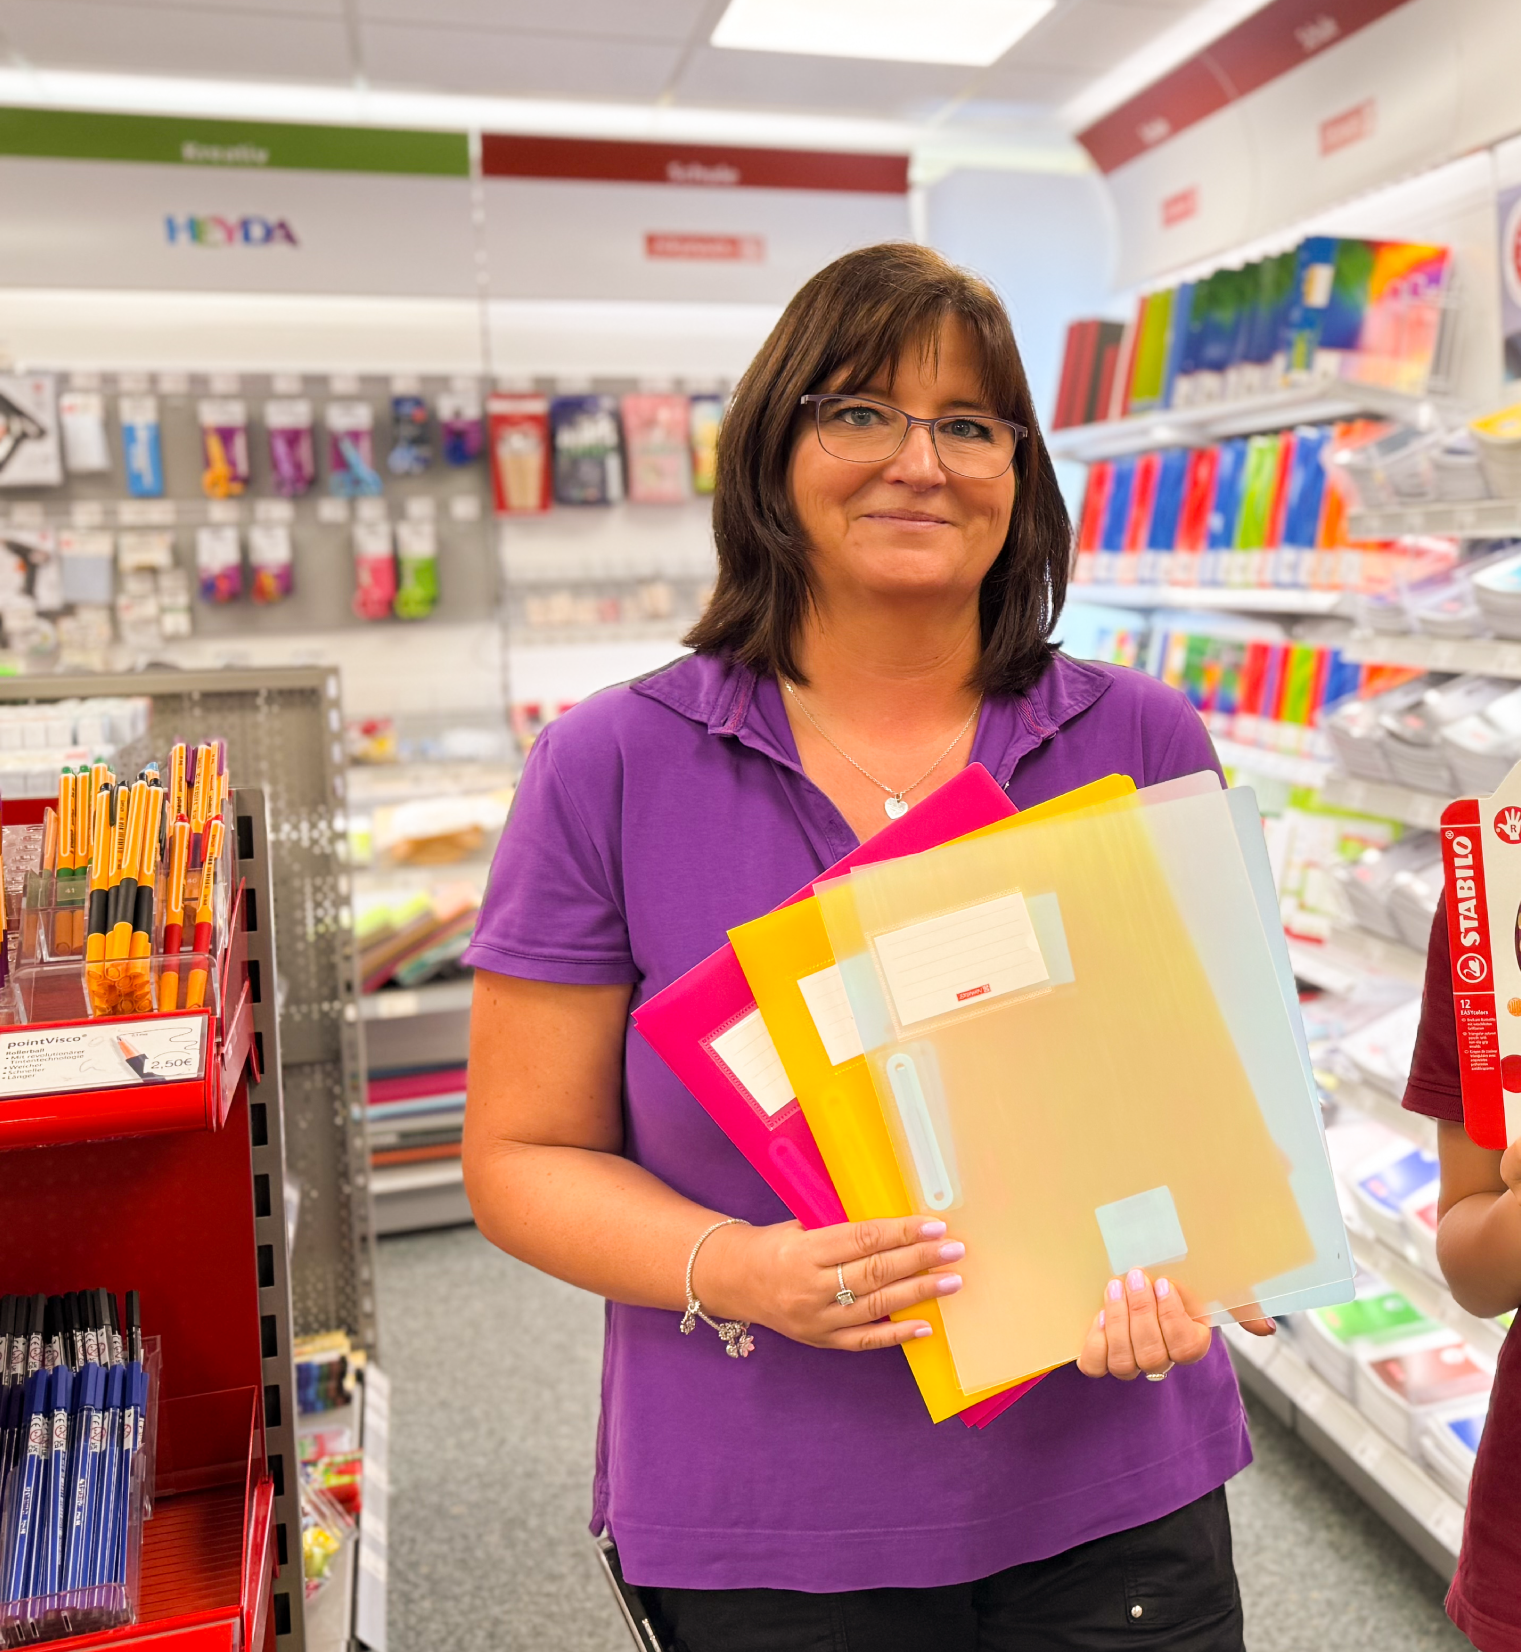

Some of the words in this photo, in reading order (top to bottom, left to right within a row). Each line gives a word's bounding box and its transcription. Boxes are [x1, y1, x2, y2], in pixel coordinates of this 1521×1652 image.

[182, 141, 268, 165] Kreativ
[165, 215, 298, 247] HEYDA
[64, 886, 75, 894] 41
[1452, 836, 1481, 947] STABILO
[1460, 999, 1471, 1009] 12
[8, 1034, 81, 1049] pointVisco
[6, 1048, 45, 1056] Rollerball
[27, 1050, 85, 1060] revolutionärer
[10, 1054, 84, 1064] Tintentechnologie
[150, 1058, 192, 1070] 2,50€
[8, 1067, 45, 1075] Schneller
